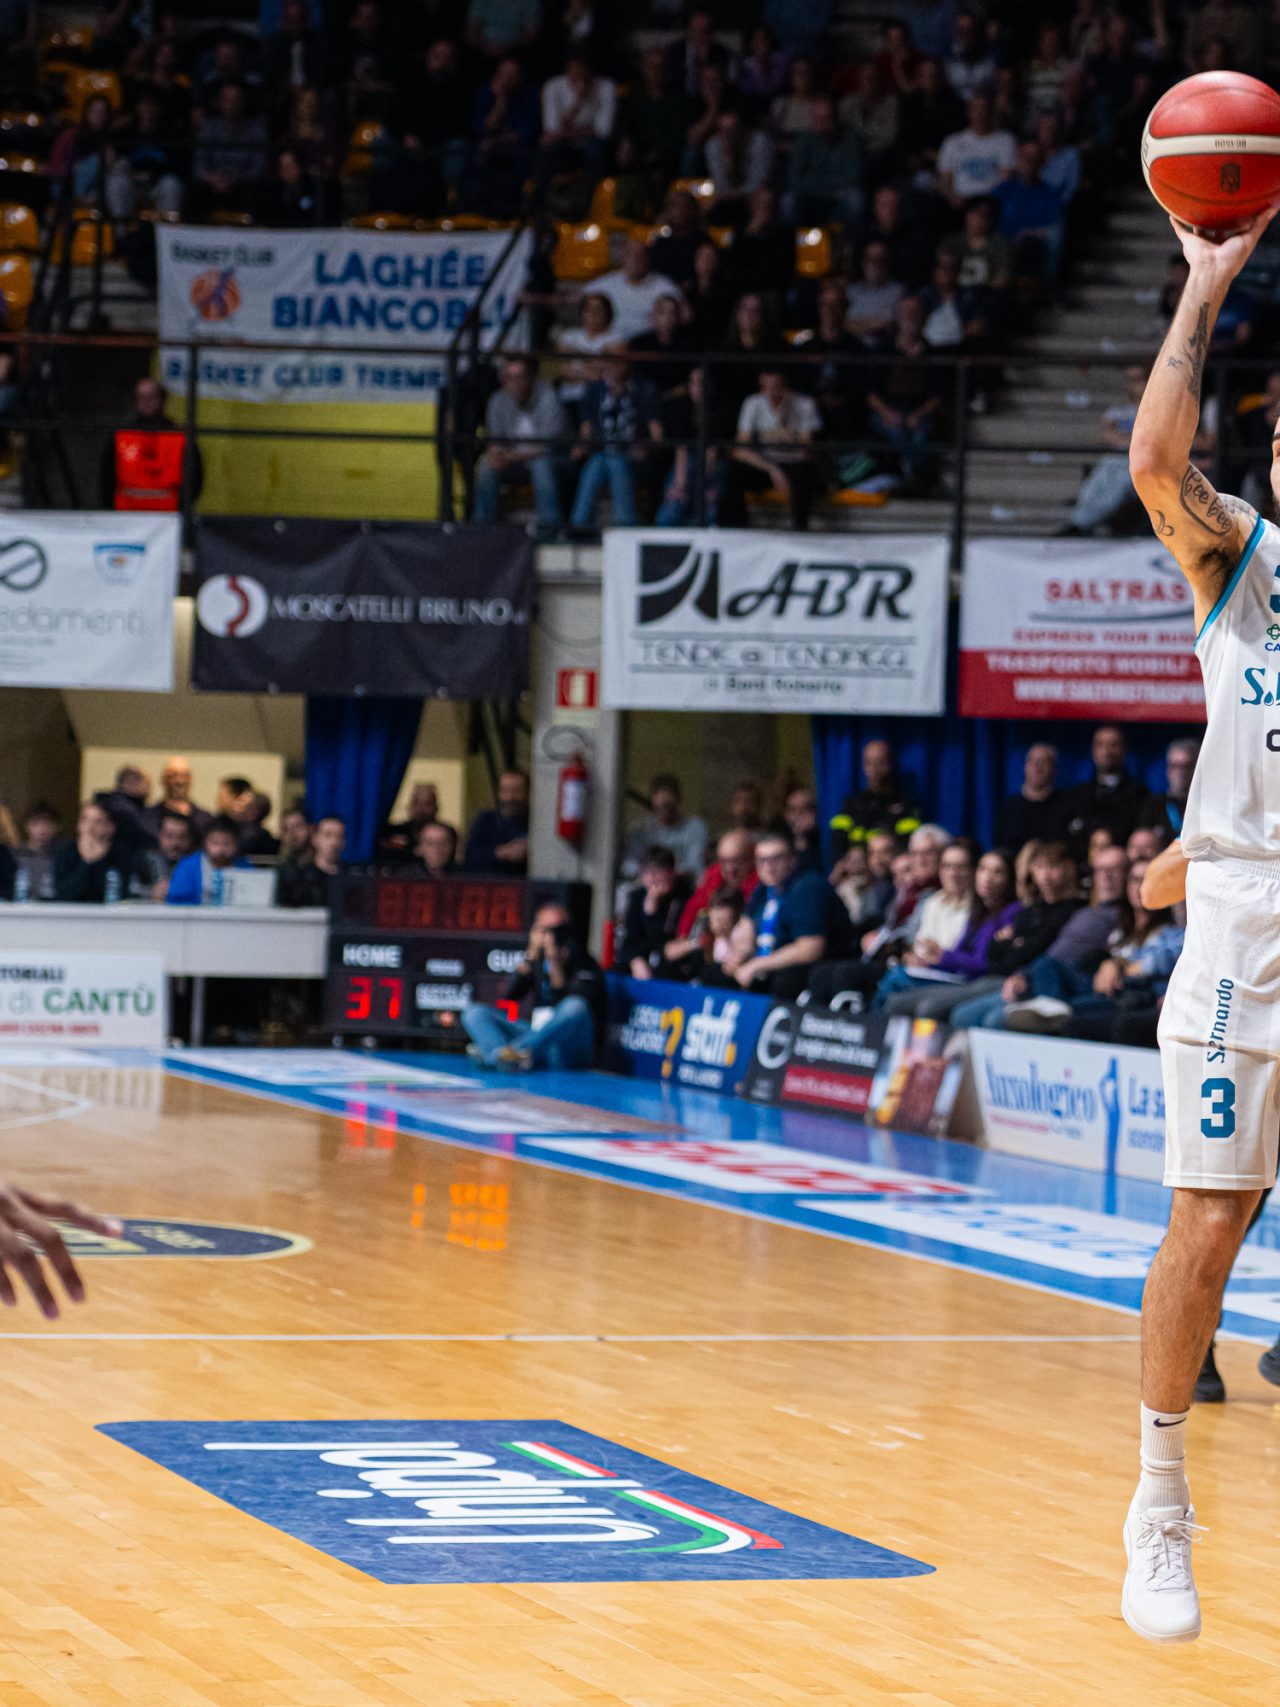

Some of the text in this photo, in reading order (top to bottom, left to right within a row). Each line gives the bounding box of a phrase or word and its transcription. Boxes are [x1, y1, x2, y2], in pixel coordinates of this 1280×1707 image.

[314, 247, 487, 289] LAGHÉE
[268, 592, 414, 624] MOSCATELLI
[418, 596, 514, 626] BRUNO
[724, 561, 914, 620] ABR
[343, 943, 402, 969] HOME
[43, 981, 155, 1017] CANTÙ
[345, 976, 403, 1021] 37
[1200, 1077, 1236, 1138] 3
[203, 1440, 662, 1545] Unipol
